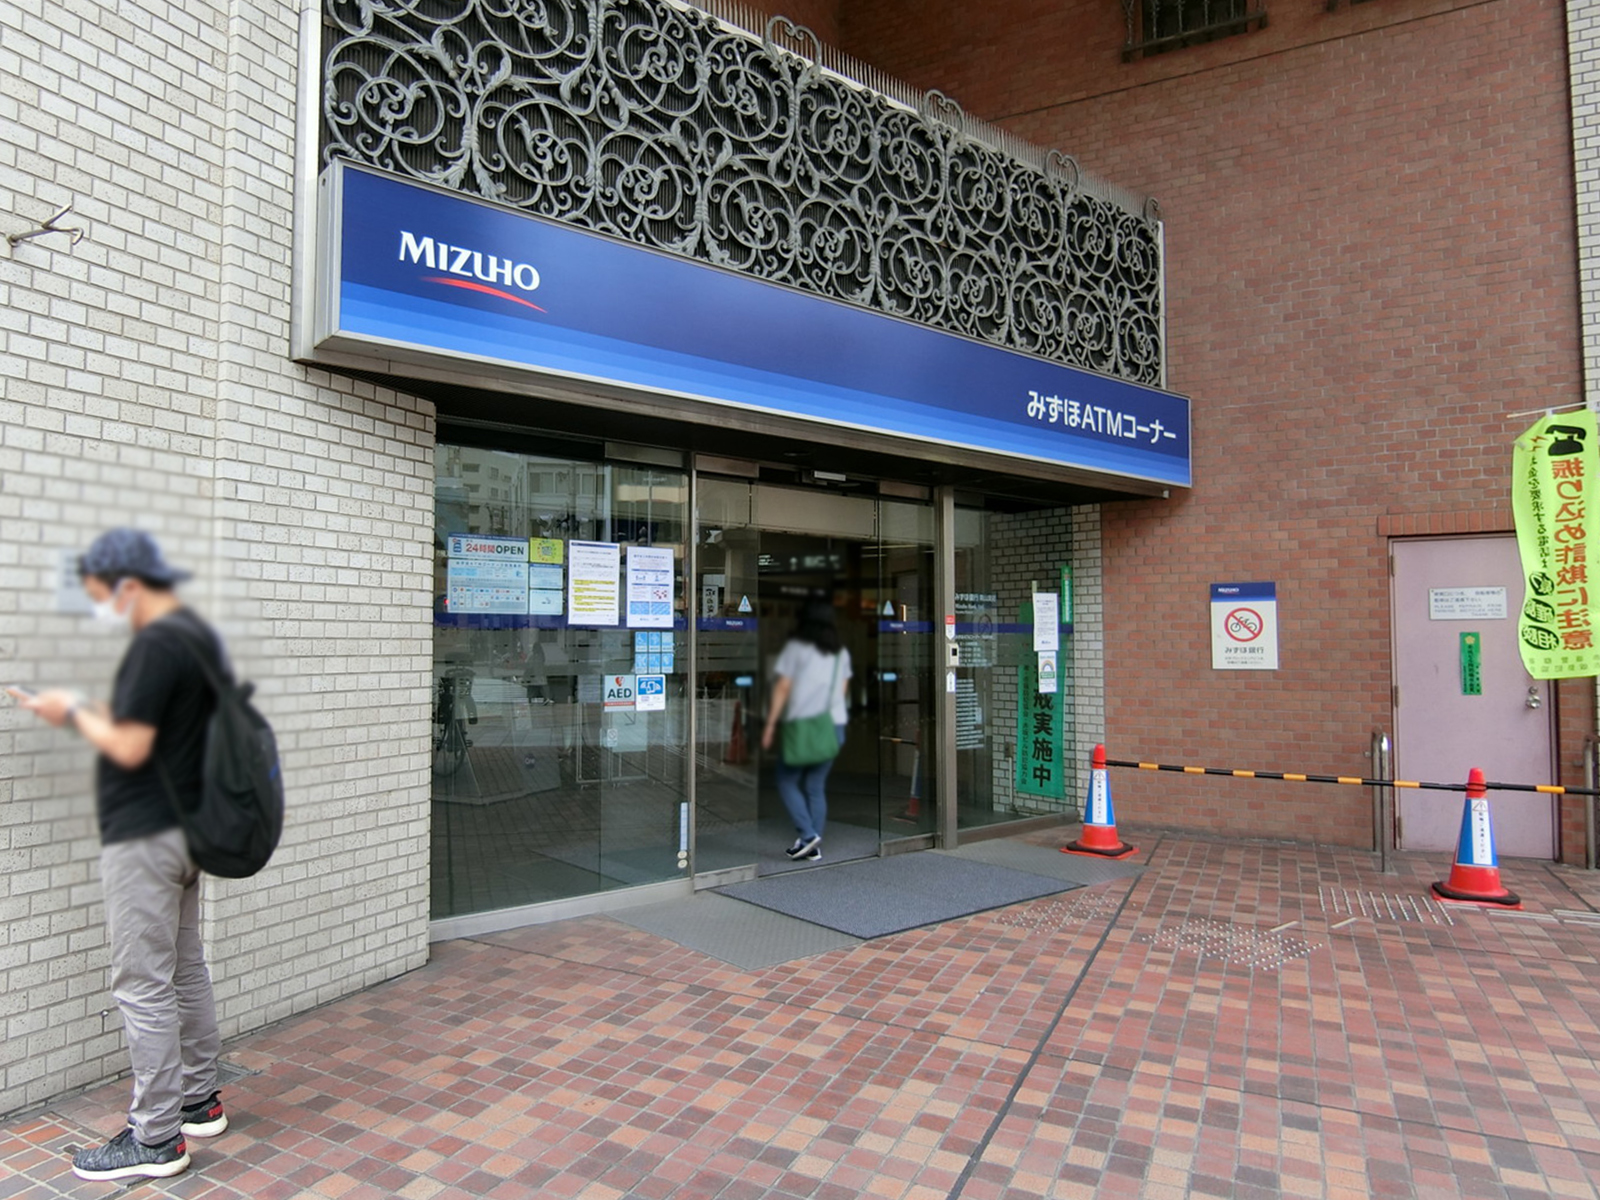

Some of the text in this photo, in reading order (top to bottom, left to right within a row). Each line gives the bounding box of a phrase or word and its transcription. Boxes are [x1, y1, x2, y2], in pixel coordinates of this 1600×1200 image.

[399, 230, 541, 291] MIZUHO
[1026, 390, 1177, 444] みずほATMコーナー
[465, 543, 525, 555] 24時間OPEN
[607, 688, 632, 699] AED
